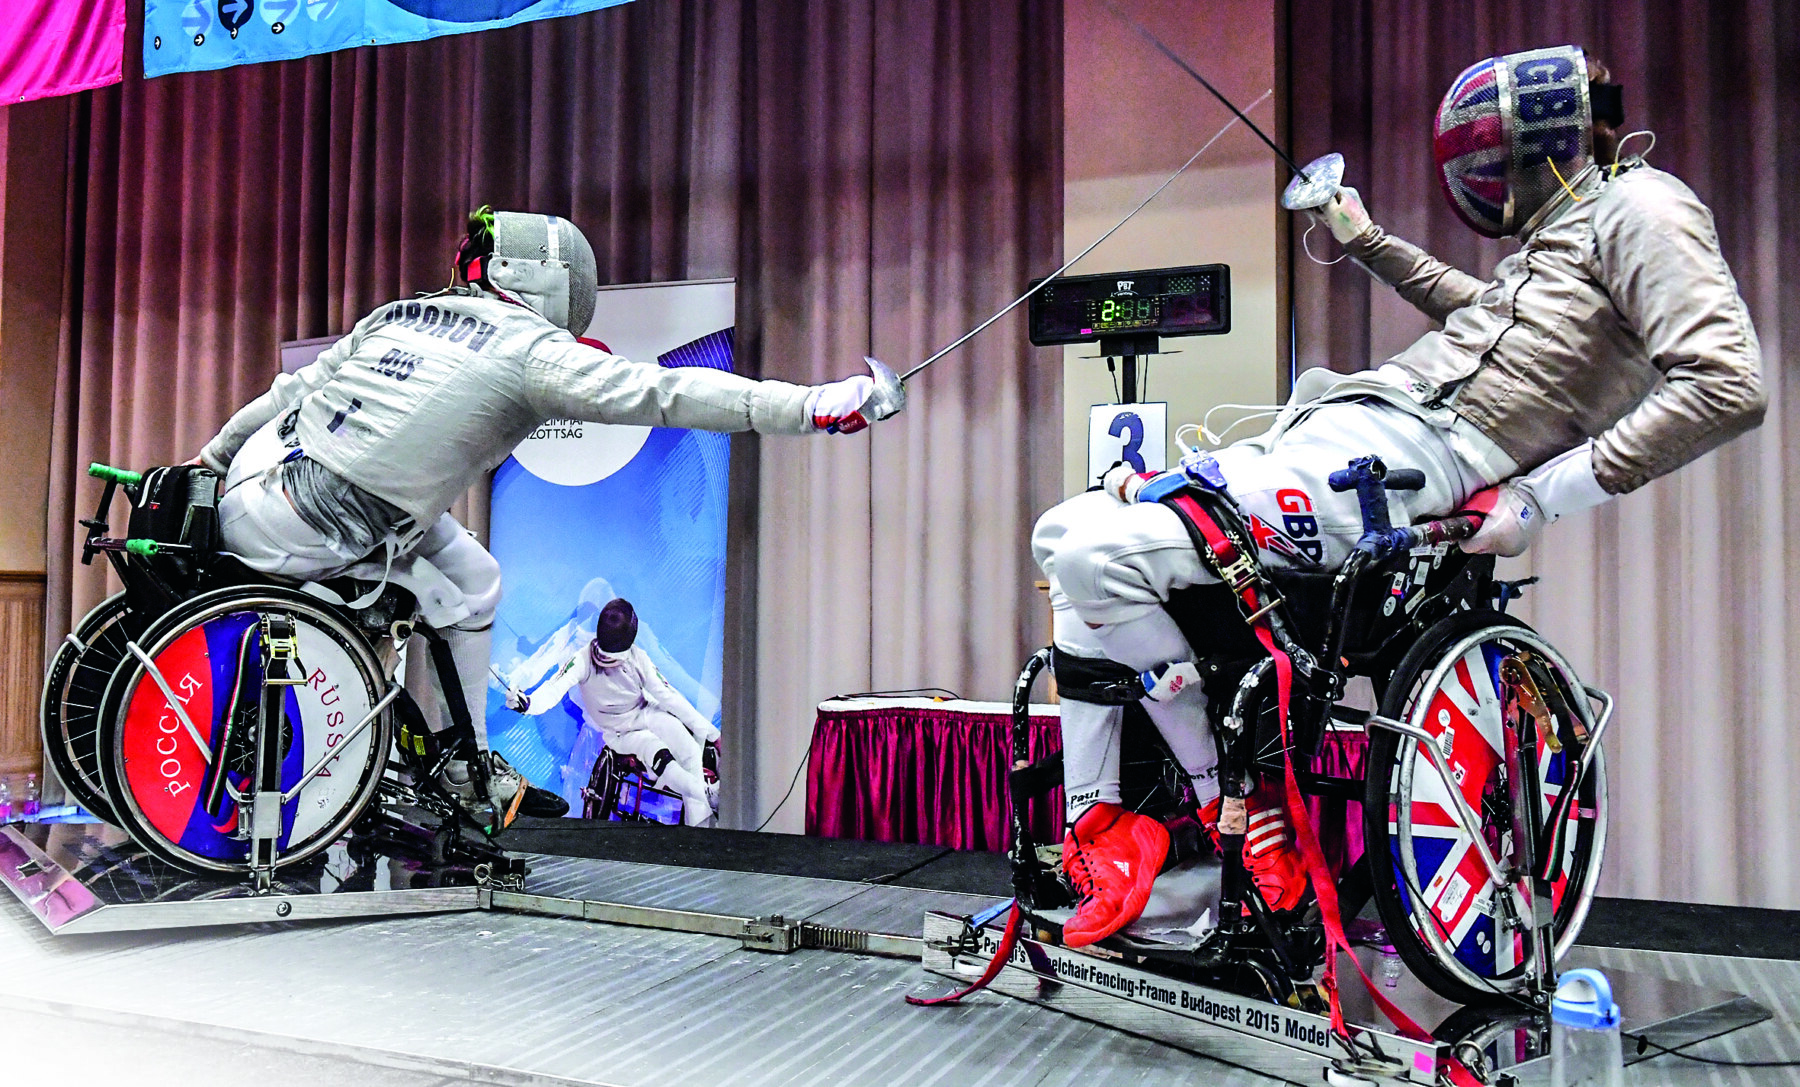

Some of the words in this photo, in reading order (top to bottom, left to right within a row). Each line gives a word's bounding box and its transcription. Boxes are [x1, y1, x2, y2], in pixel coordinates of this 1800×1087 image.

[1513, 57, 1580, 168] GBR
[370, 347, 424, 382] RUS
[1108, 411, 1147, 474] 3
[1070, 789, 1100, 806] Paul
[1181, 990, 1241, 1024] Budapest
[1245, 1008, 1280, 1034] 2015
[1285, 1017, 1330, 1048] Model
